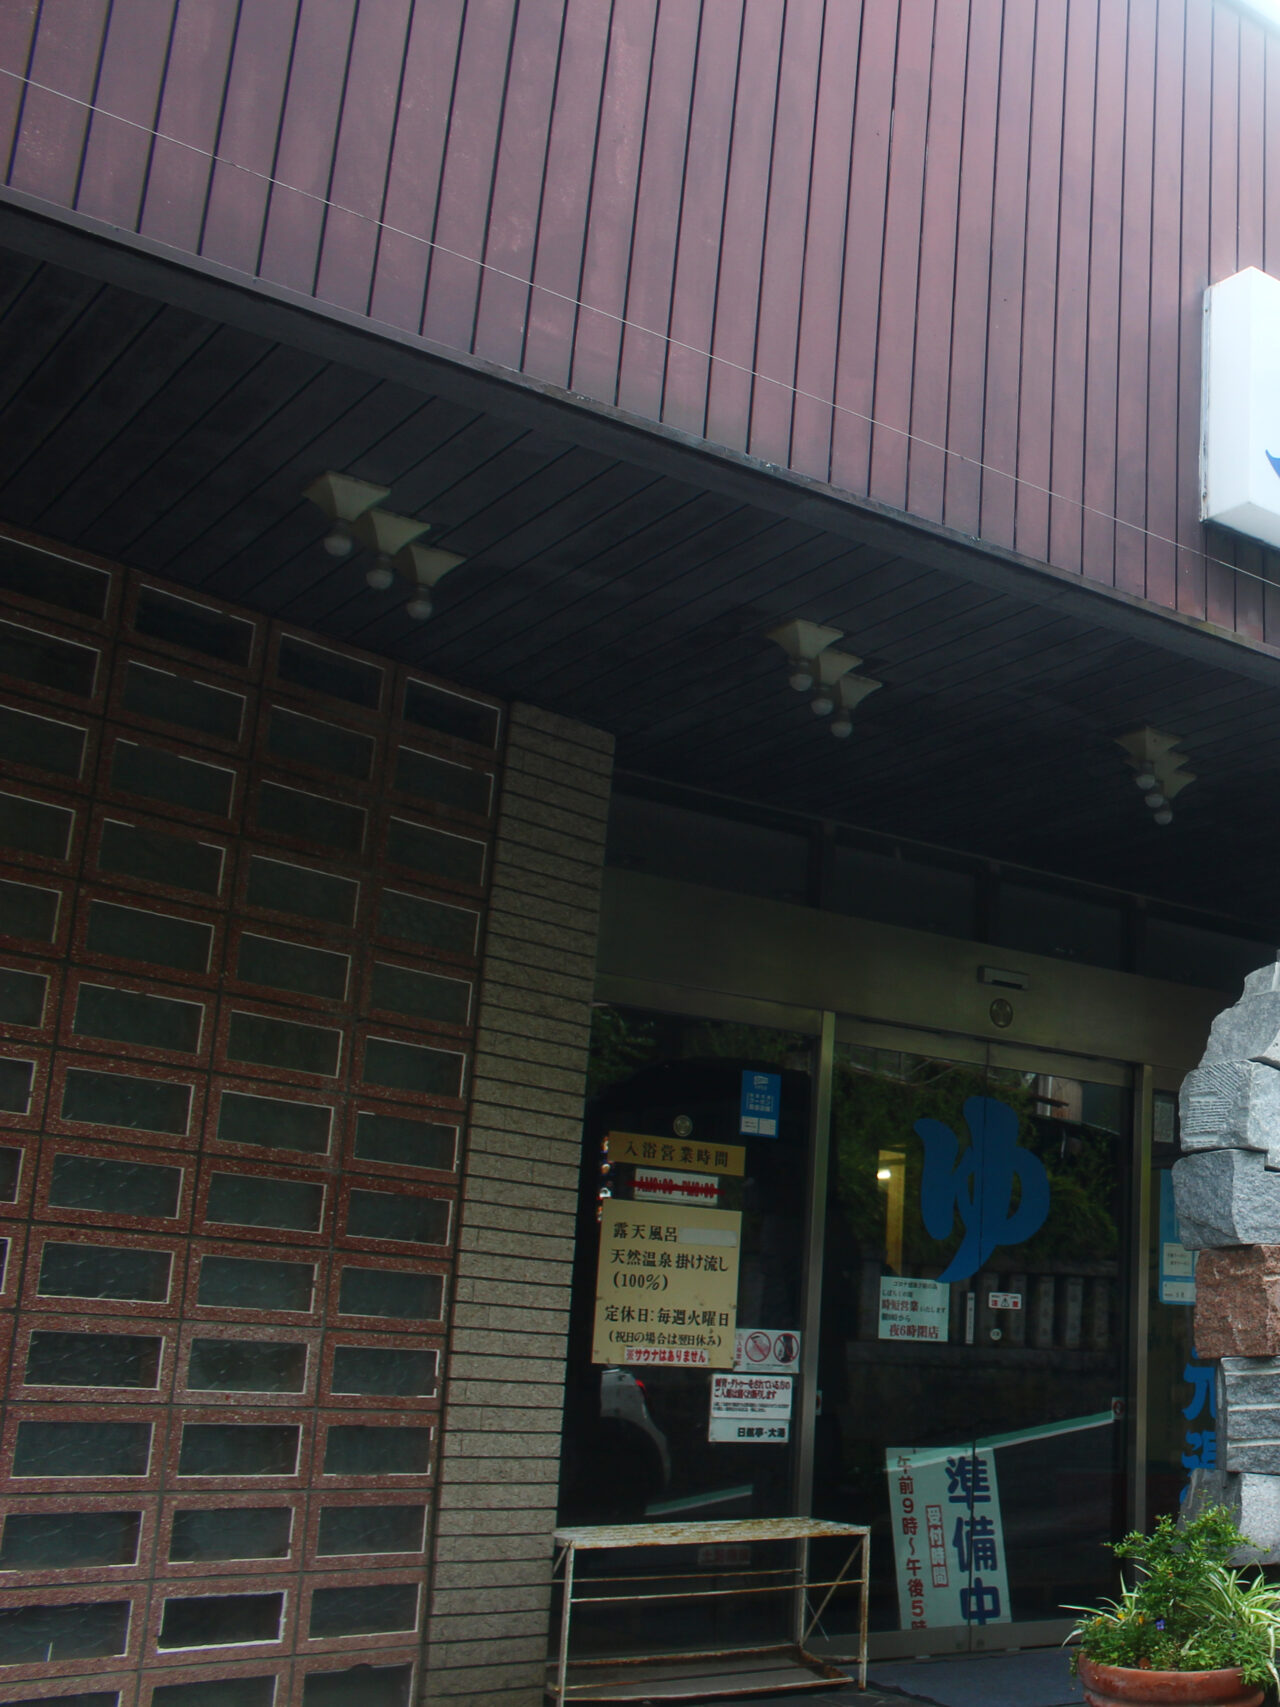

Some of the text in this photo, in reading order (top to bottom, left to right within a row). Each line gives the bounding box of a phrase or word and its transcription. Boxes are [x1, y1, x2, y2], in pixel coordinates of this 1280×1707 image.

[625, 1140, 729, 1167] 入浴営業時間
[914, 1096, 1050, 1283] ゆ
[613, 1222, 678, 1243] 露天風呂
[613, 1271, 669, 1291] (100%)
[889, 1323, 939, 1339] 夜6時閉店
[917, 1455, 1001, 1626] 準備中
[926, 1505, 949, 1588] 受付時間
